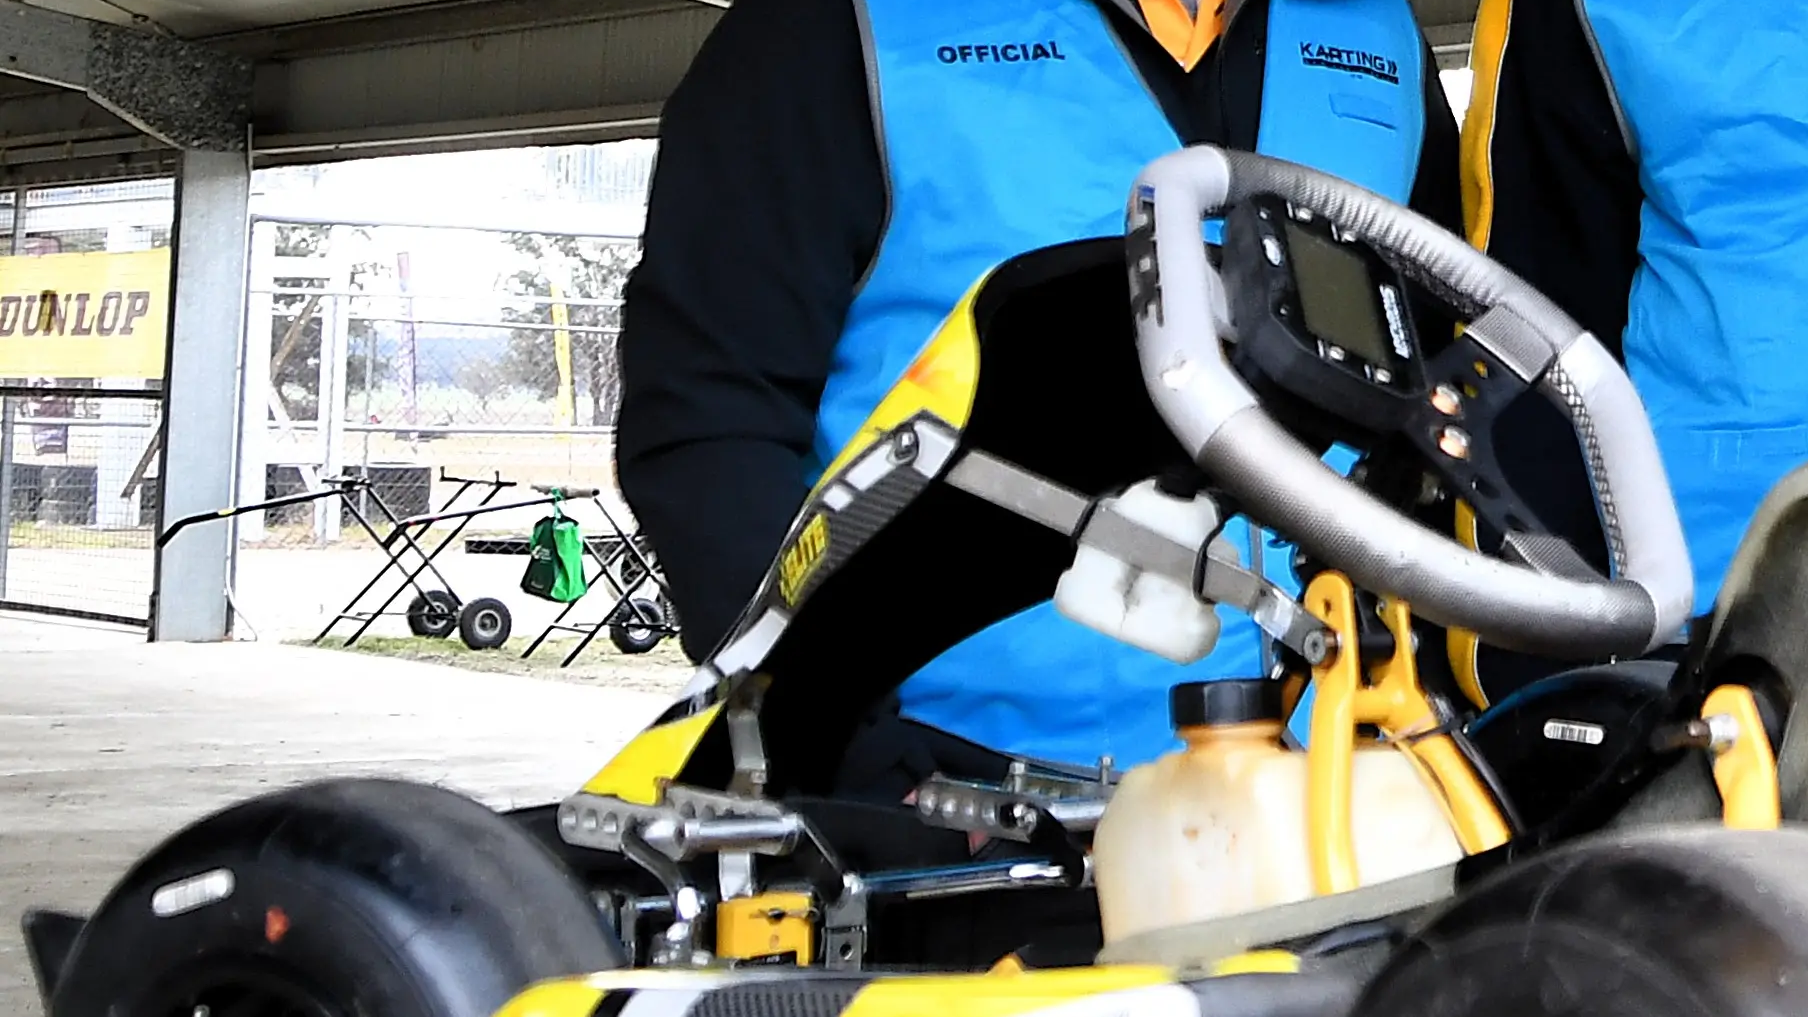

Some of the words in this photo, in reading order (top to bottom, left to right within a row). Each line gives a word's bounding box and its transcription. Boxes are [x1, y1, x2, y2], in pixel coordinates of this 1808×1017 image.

[936, 40, 1066, 65] OFFICIAL
[1299, 41, 1386, 72] KARTING
[0, 291, 151, 337] DUNLOP
